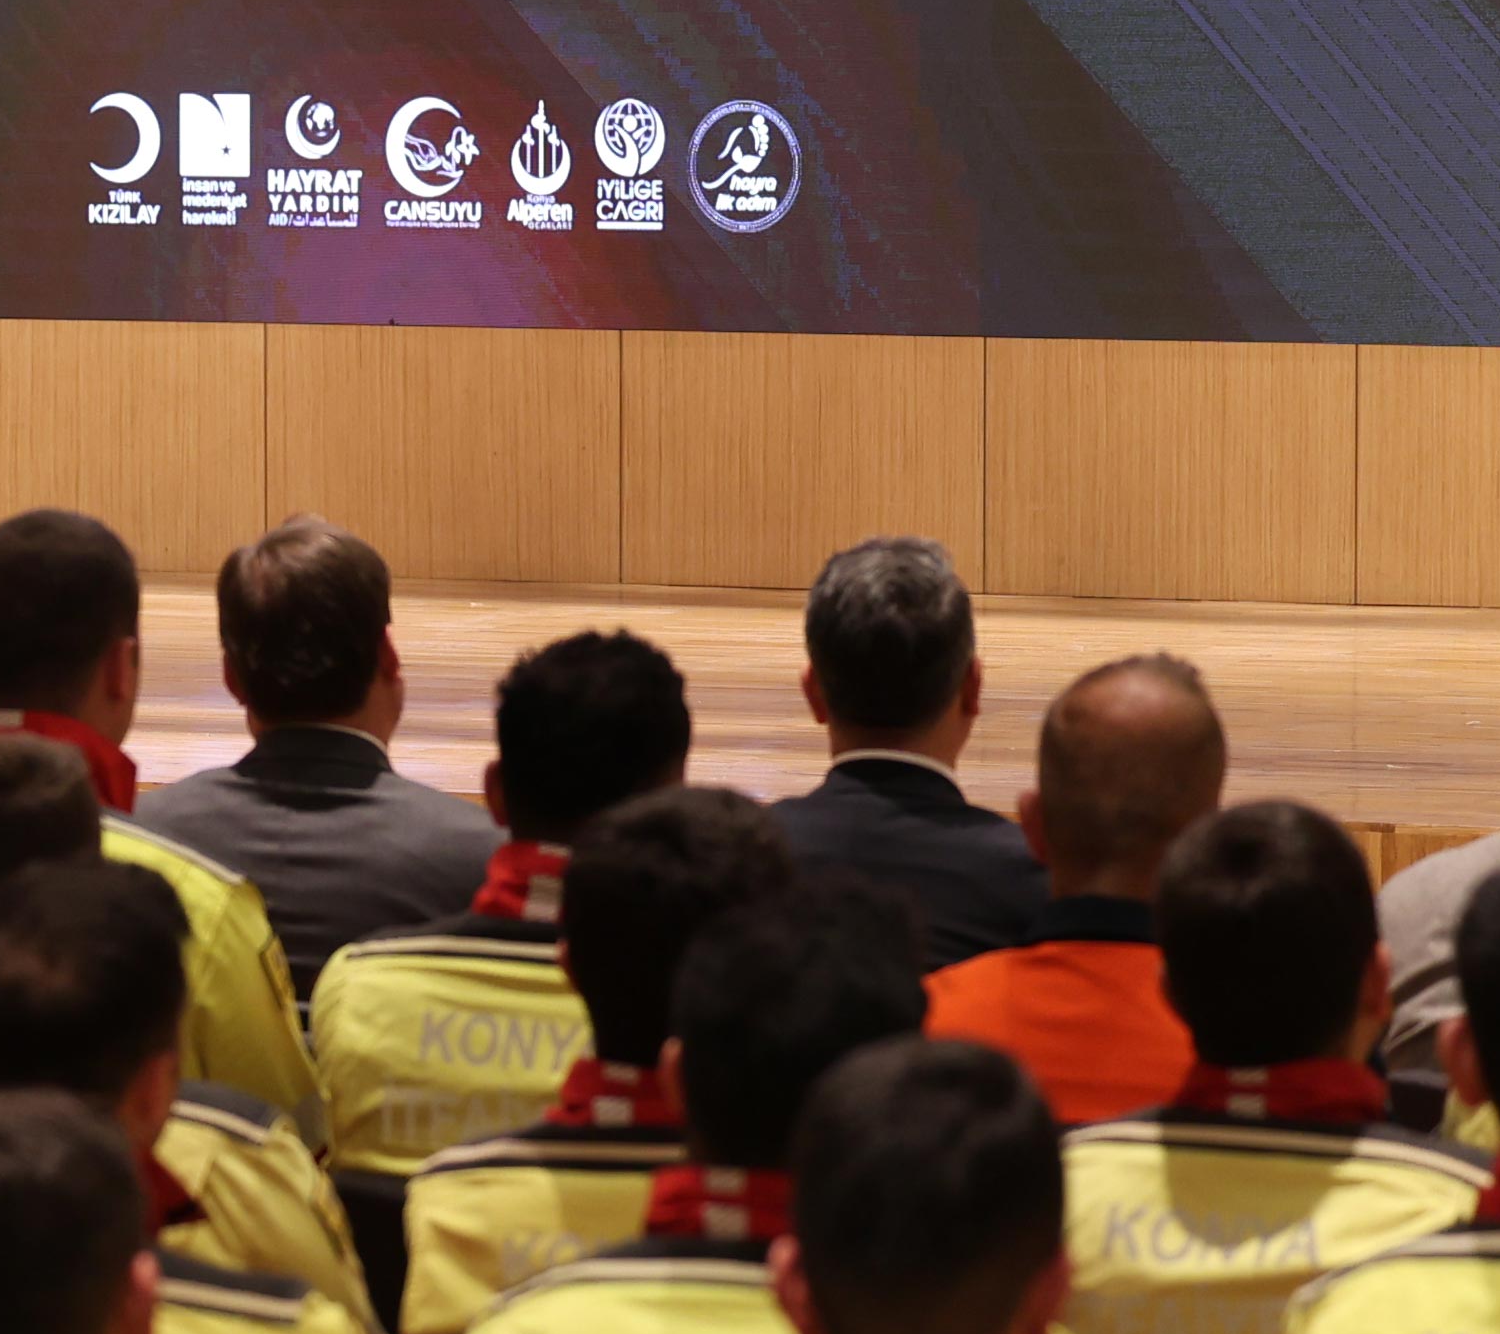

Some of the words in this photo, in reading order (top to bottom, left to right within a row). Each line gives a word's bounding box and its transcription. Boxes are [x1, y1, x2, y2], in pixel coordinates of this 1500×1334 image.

[219, 180, 236, 194] ve
[267, 169, 363, 194] HAYRAT
[109, 189, 141, 204] TÜRK
[268, 194, 359, 213] YARDIM
[88, 204, 161, 225] KIZILAY
[384, 200, 482, 222] CANSUYU
[506, 198, 573, 226] Alperen
[418, 1009, 596, 1071] KONY
[1102, 1201, 1324, 1269] KONYA
